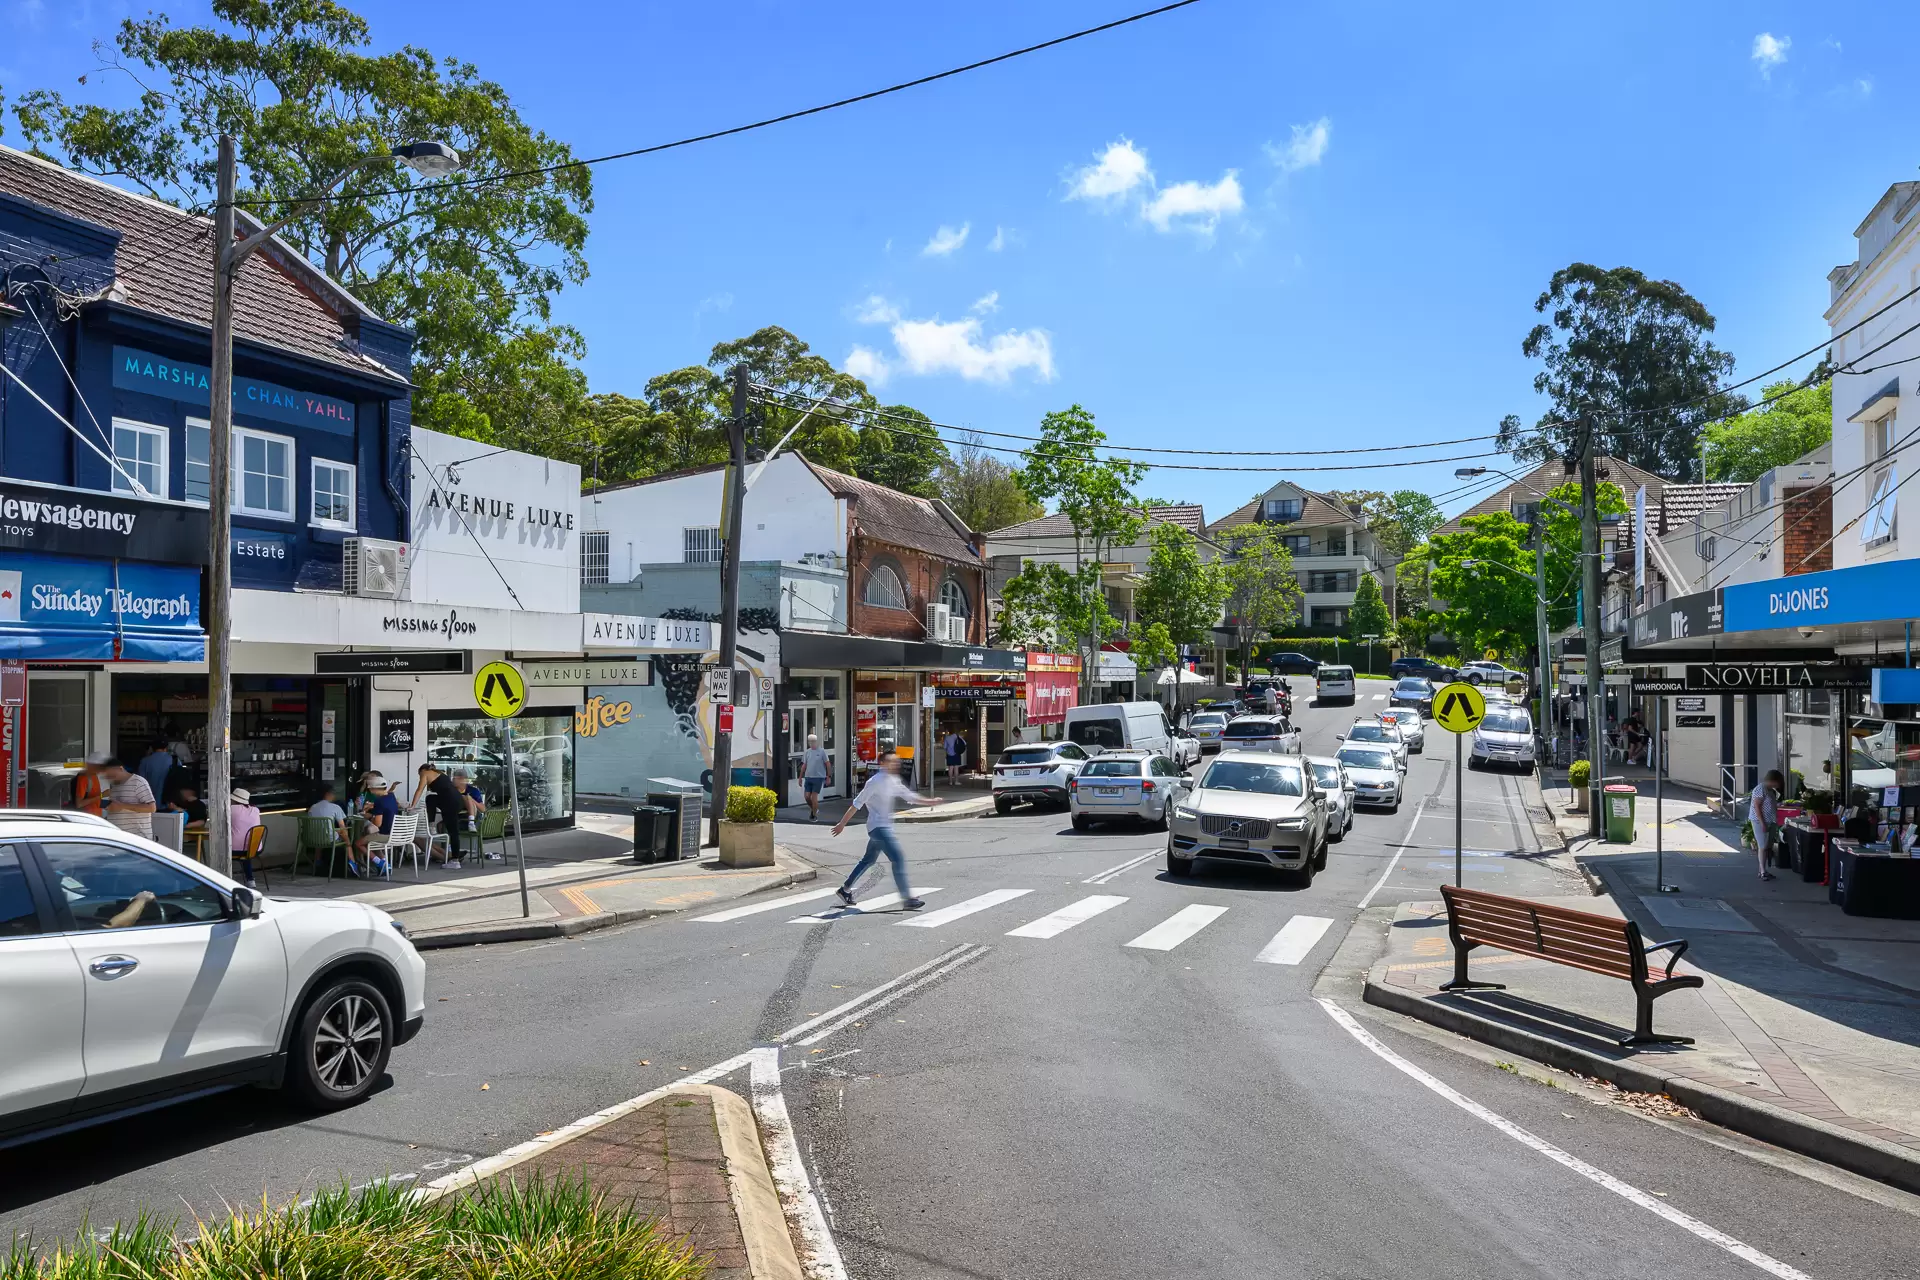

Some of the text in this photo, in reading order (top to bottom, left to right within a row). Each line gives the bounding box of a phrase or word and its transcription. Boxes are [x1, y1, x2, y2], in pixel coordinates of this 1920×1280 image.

[125, 357, 351, 421] MARSHA. CHAN. YAHL.
[428, 488, 574, 531] AVENUE LUXE
[4, 525, 34, 537] TOYS
[237, 541, 285, 559] Estate
[32, 584, 191, 620] The Sunday Telegraph
[1769, 586, 1829, 614] DiJONES
[383, 609, 477, 641] MISSING SPOON
[593, 621, 701, 643] AVENUE LUXE
[1, 666, 24, 675] STOPPING
[533, 668, 638, 680] AVENUE LUXE
[677, 663, 696, 672] PUBLIC
[713, 671, 728, 680] ONE
[1702, 667, 1814, 687] NOVELLA
[712, 682, 728, 691] WAY
[1634, 683, 1682, 691] WAHROONGA
[387, 718, 411, 726] MISSING
[567, 695, 632, 737] offee
